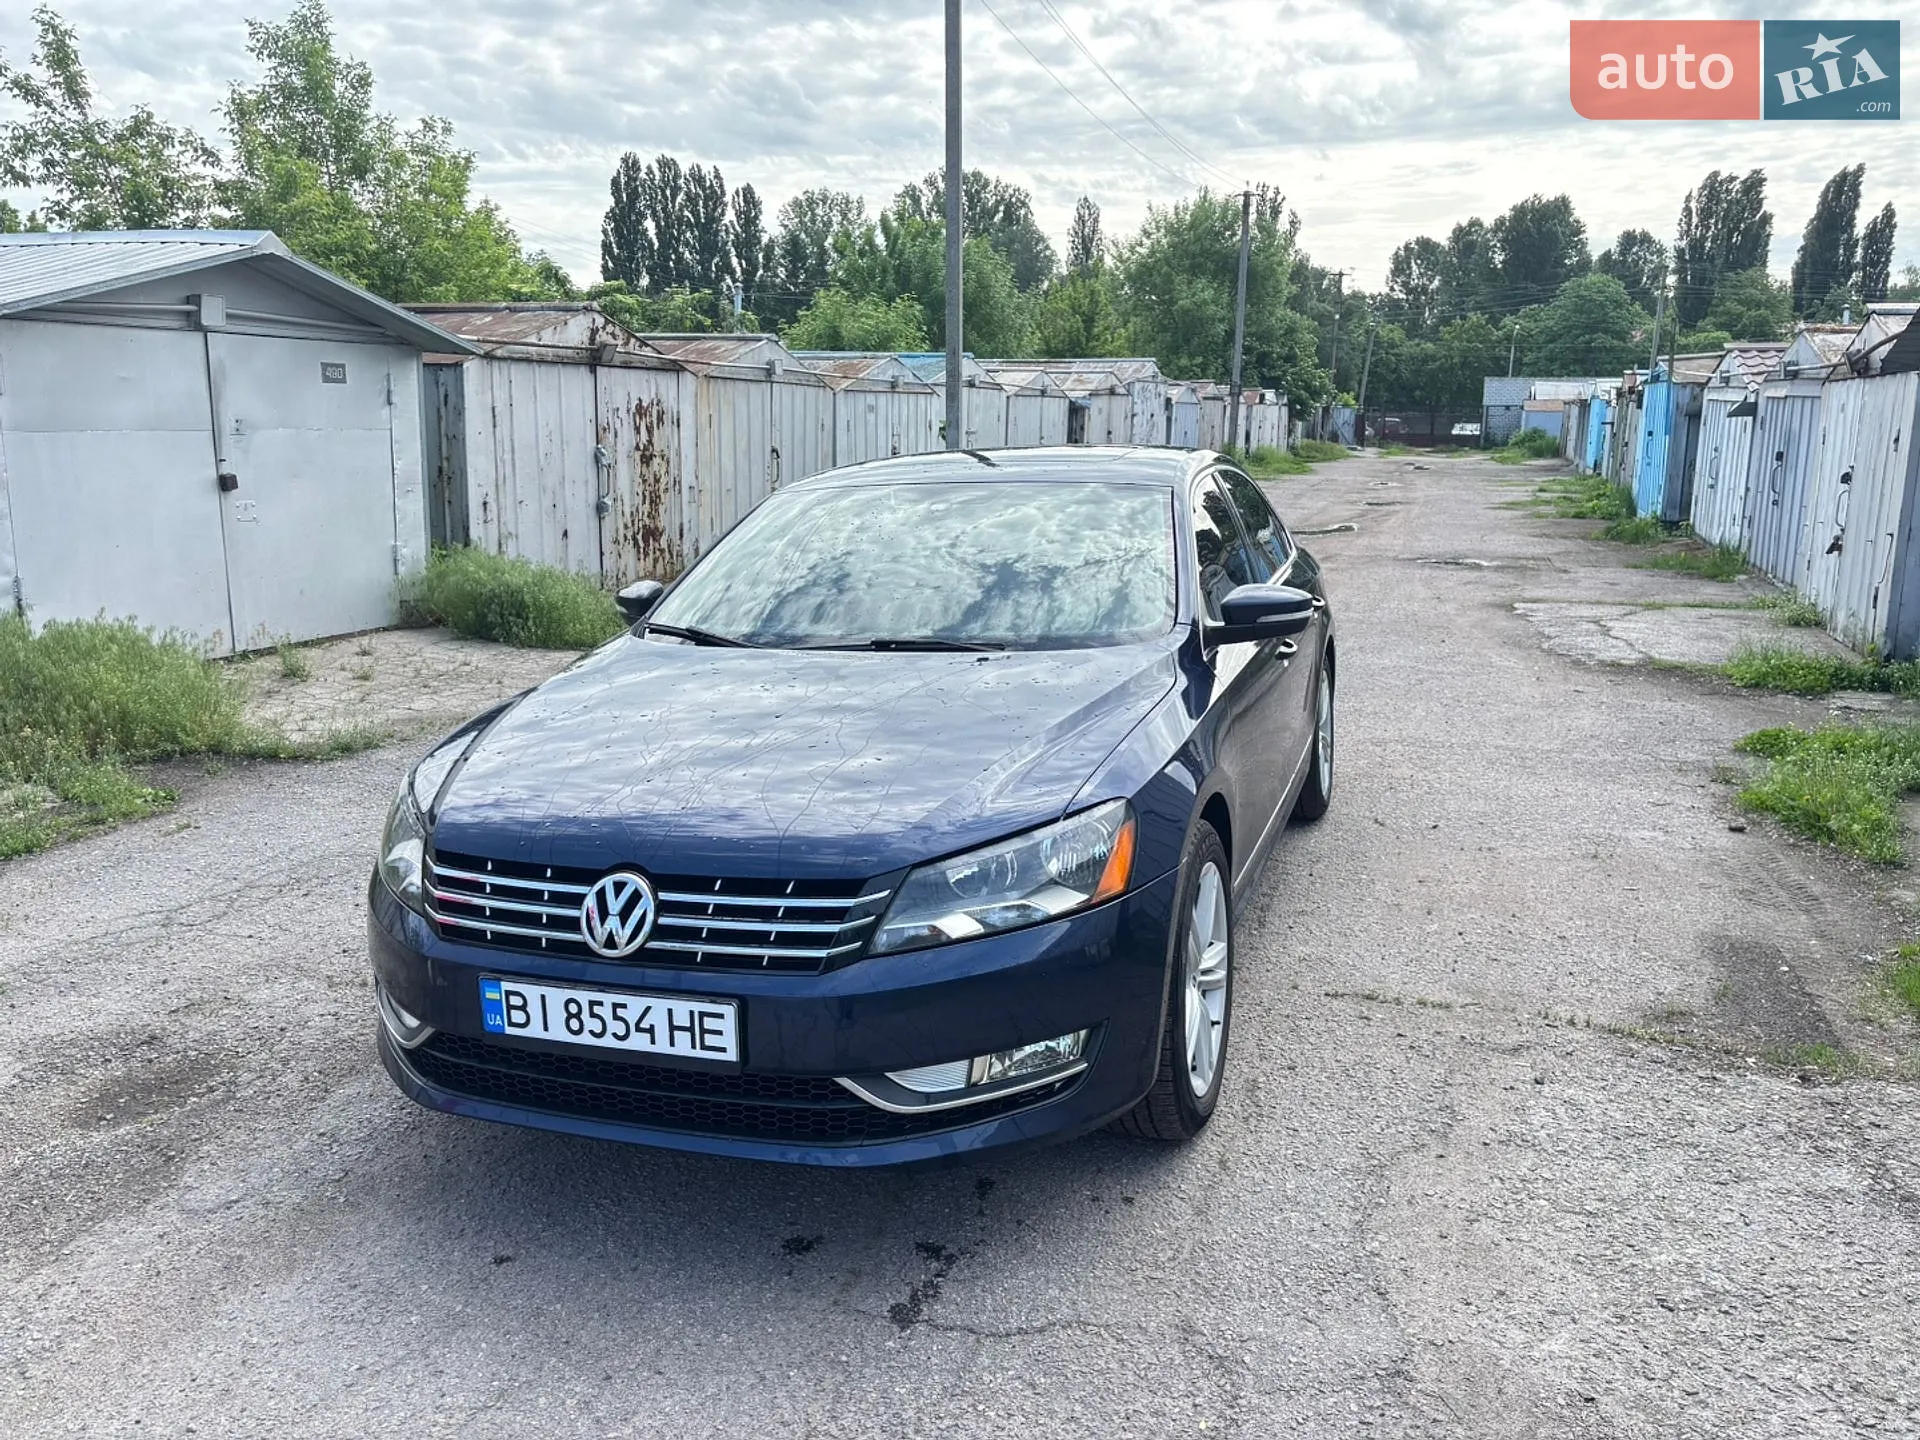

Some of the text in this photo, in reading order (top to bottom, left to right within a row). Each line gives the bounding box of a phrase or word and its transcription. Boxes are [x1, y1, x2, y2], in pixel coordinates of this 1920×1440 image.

[487, 1013, 504, 1026] UA
[504, 989, 728, 1053] BI 8554 HE
